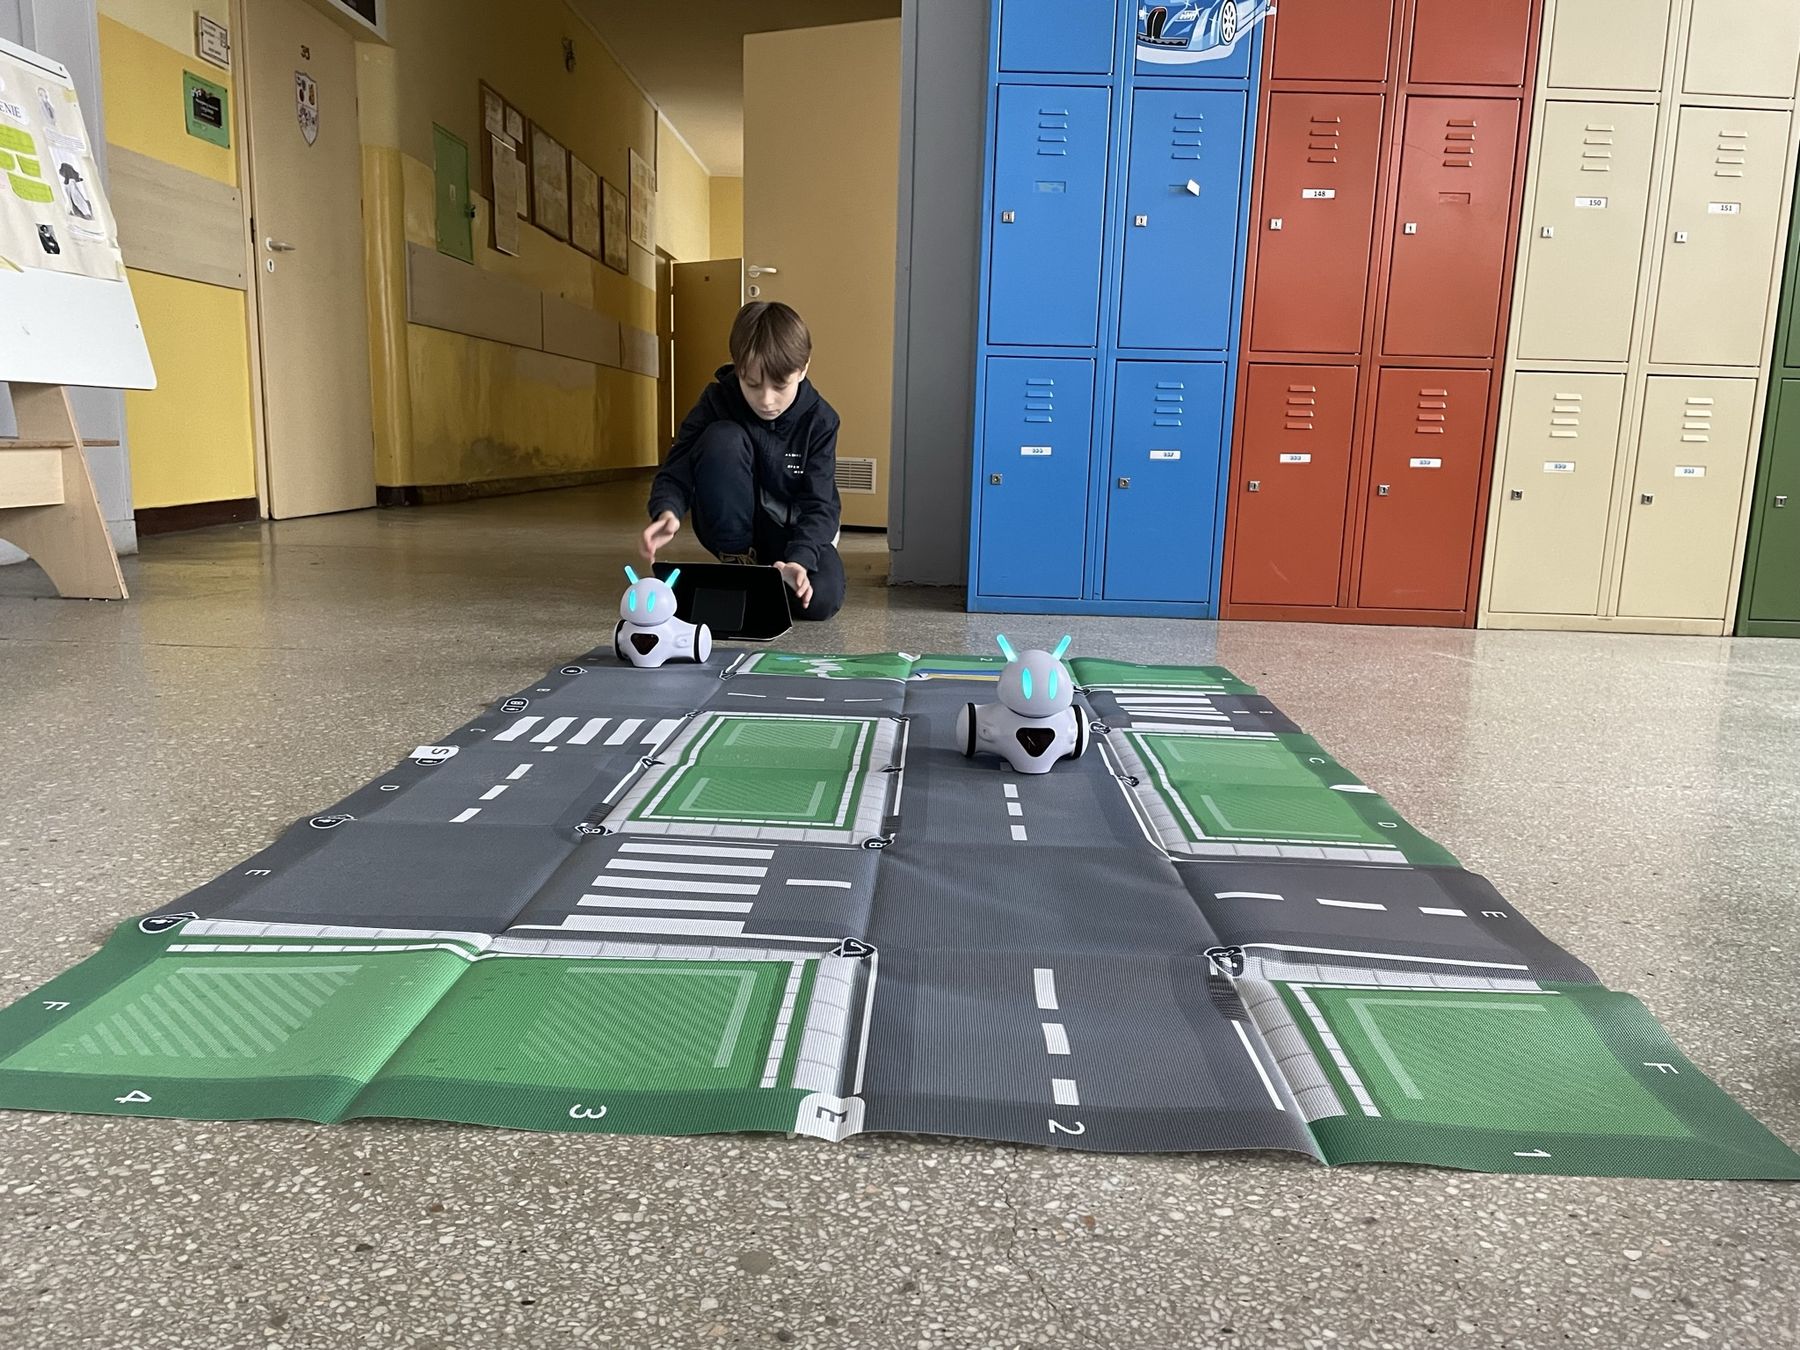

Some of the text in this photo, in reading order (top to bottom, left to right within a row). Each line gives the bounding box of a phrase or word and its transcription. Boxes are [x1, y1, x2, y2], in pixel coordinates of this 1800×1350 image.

[1481, 910, 1508, 919] E
[43, 1000, 71, 1011] F
[1643, 1062, 1679, 1075] F
[114, 1090, 152, 1104] 4
[569, 1103, 607, 1119] 3
[816, 1105, 848, 1123] E
[1048, 1119, 1086, 1136] 2
[1513, 1148, 1551, 1157] 1
